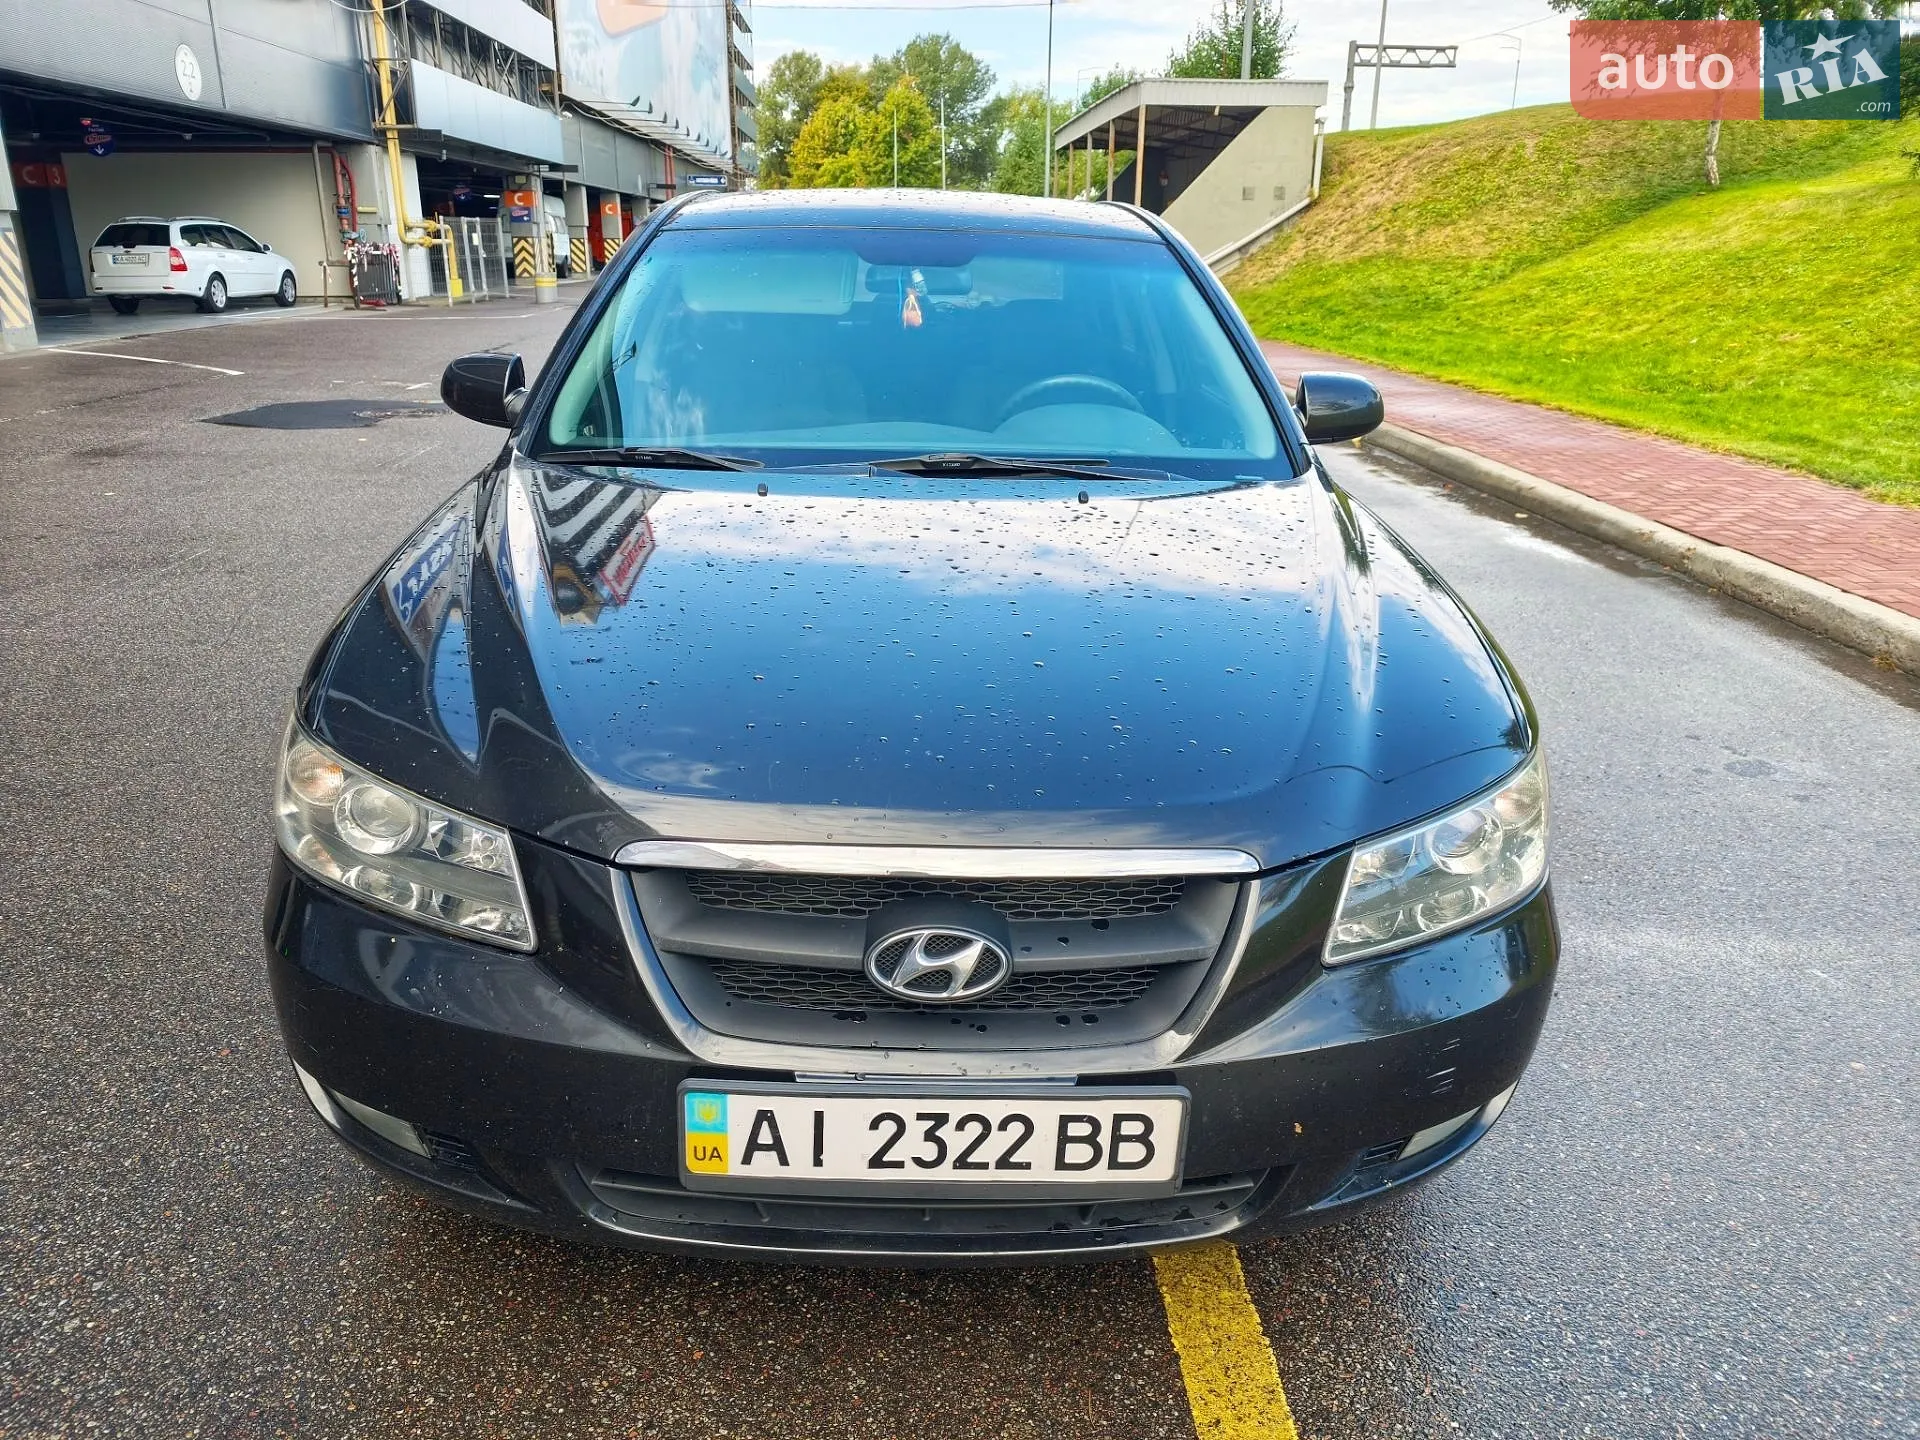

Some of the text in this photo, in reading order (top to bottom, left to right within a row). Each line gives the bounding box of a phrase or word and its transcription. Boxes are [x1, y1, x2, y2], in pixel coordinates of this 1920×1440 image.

[22, 166, 60, 184] C 3
[514, 192, 524, 206] C
[605, 204, 613, 214] C
[741, 1109, 1156, 1172] AI 2322 BB
[693, 1145, 723, 1162] UA
